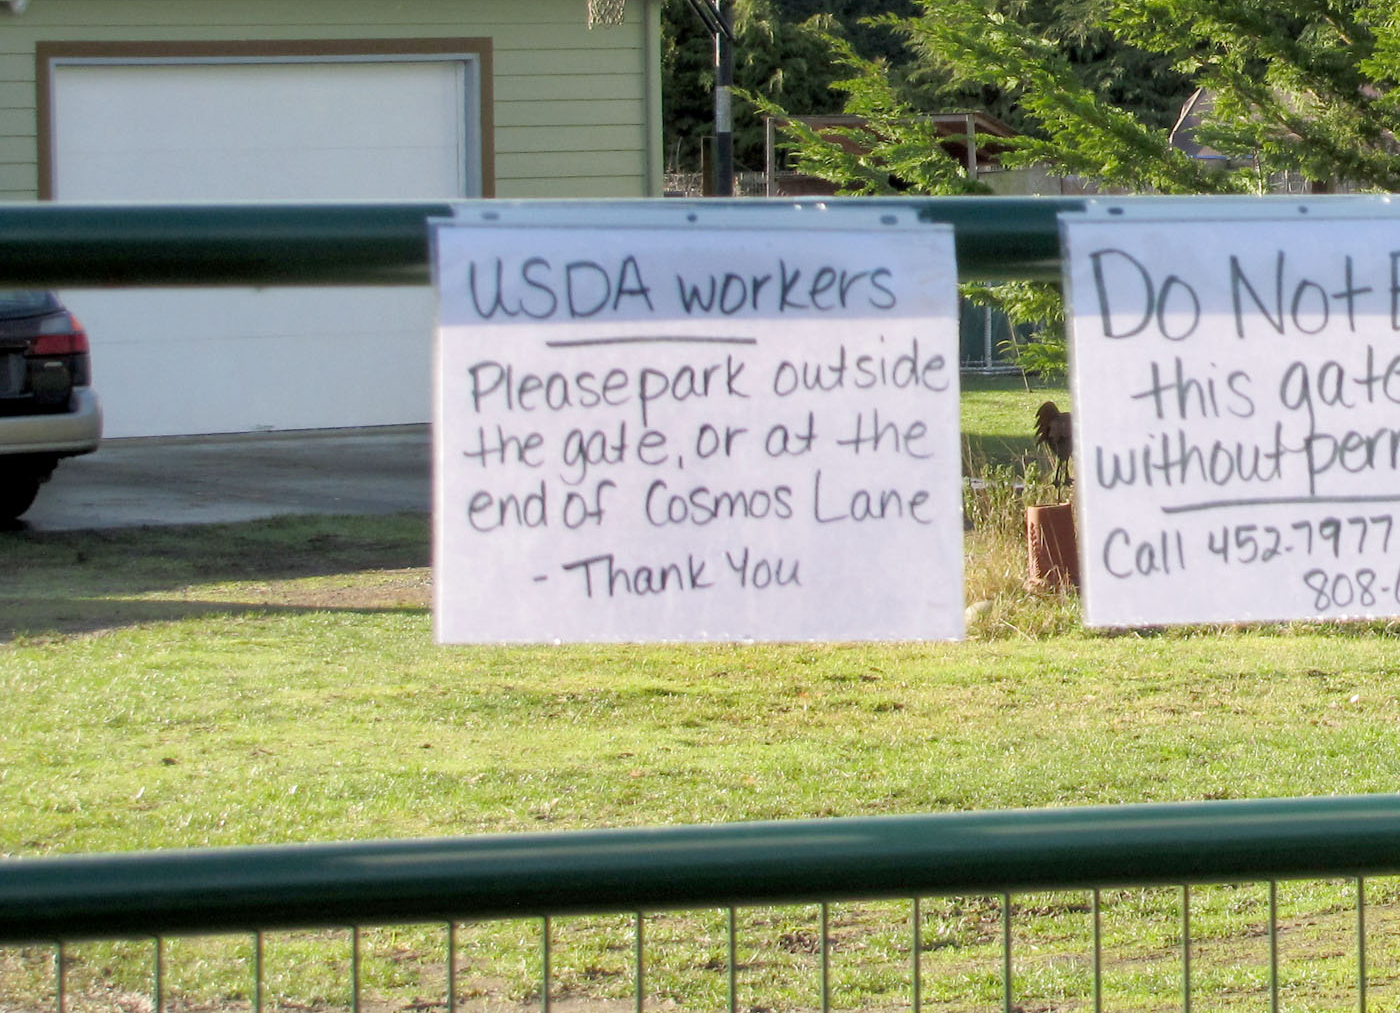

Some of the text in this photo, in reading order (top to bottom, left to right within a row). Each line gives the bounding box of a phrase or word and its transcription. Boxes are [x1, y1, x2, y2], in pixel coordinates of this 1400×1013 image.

[468, 255, 898, 320] USDA workers
[1089, 248, 1201, 341] Do
[1229, 249, 1373, 339] Not
[468, 336, 949, 428] Please park outside
[1132, 356, 1256, 420] this
[463, 409, 934, 484] the gate, or at the
[1095, 421, 1293, 489] without
[467, 470, 934, 532] end of Cosmos Lane
[726, 547, 801, 588] You
[1102, 528, 1185, 579] Call
[1207, 515, 1393, 564] 452-7977
